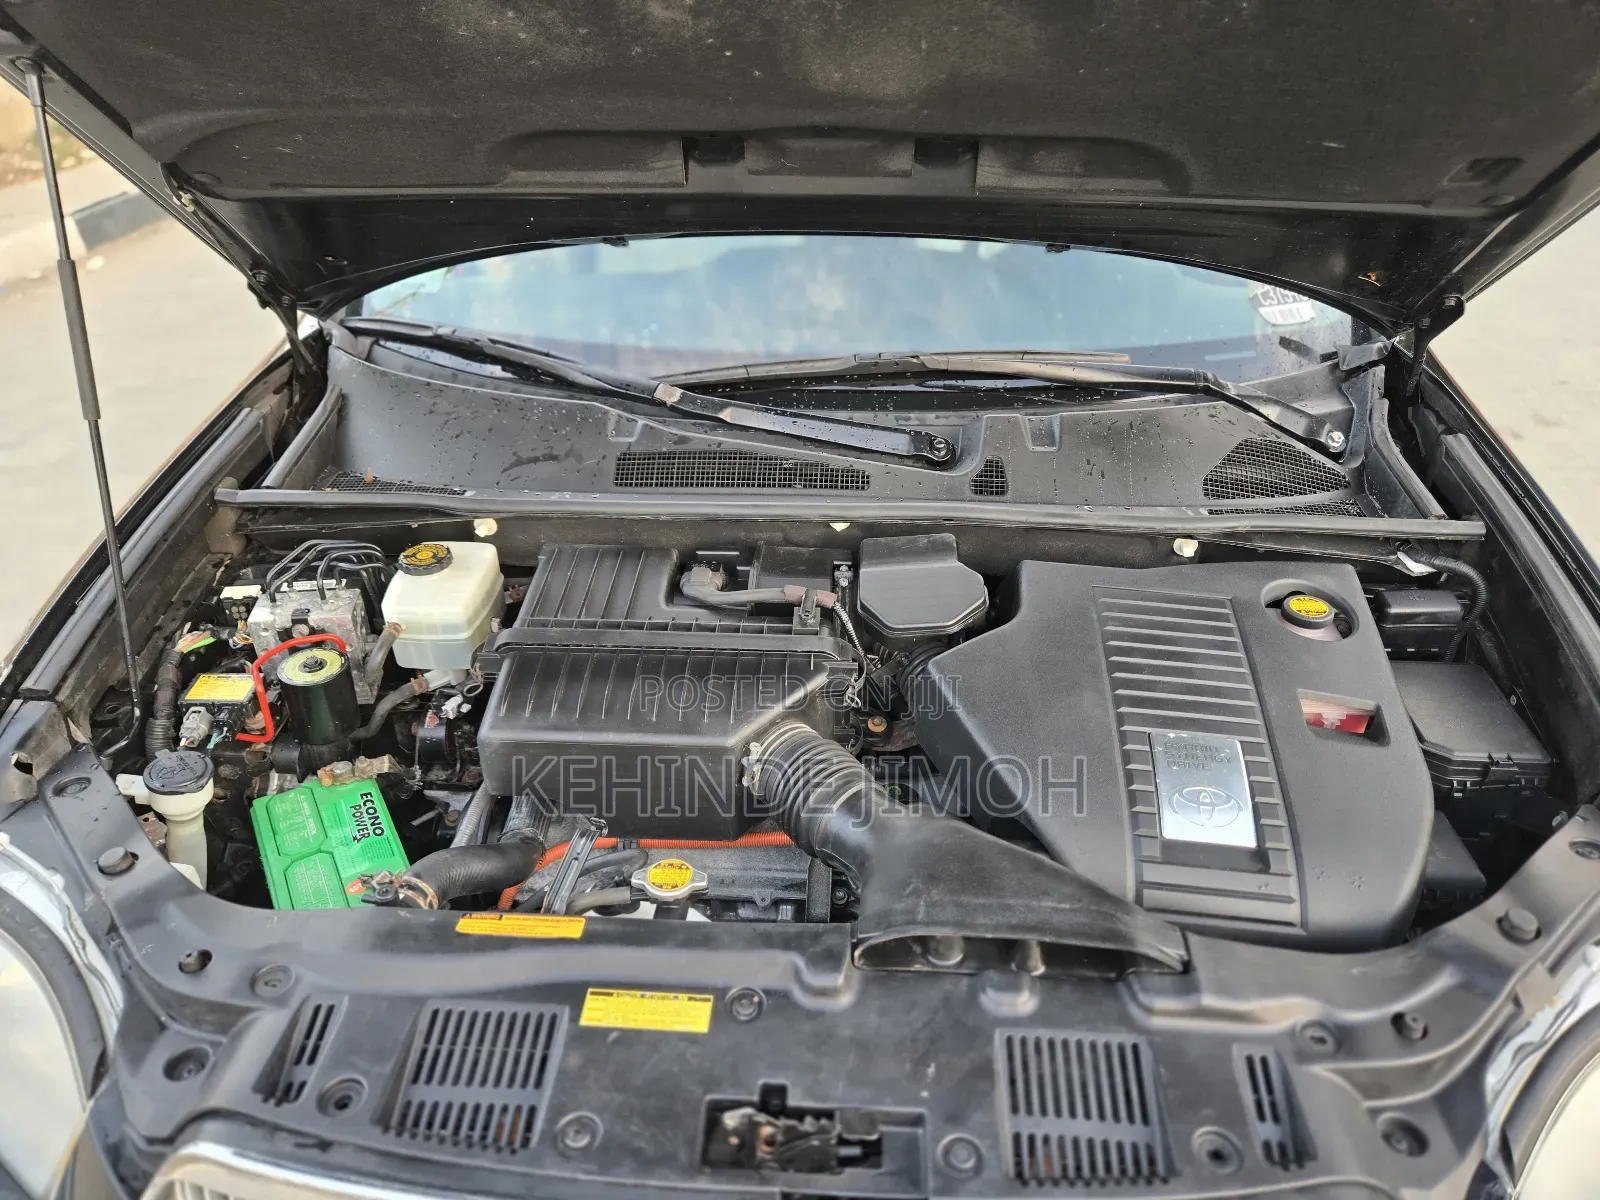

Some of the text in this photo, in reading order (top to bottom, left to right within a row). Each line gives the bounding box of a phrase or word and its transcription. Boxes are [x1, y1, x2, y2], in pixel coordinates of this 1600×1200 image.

[1164, 742, 1218, 753] HYBRID
[1165, 750, 1231, 764] SYNERGY
[1166, 759, 1211, 770] DRIVE
[360, 791, 384, 836] ECONO
[350, 804, 371, 843] POWER
